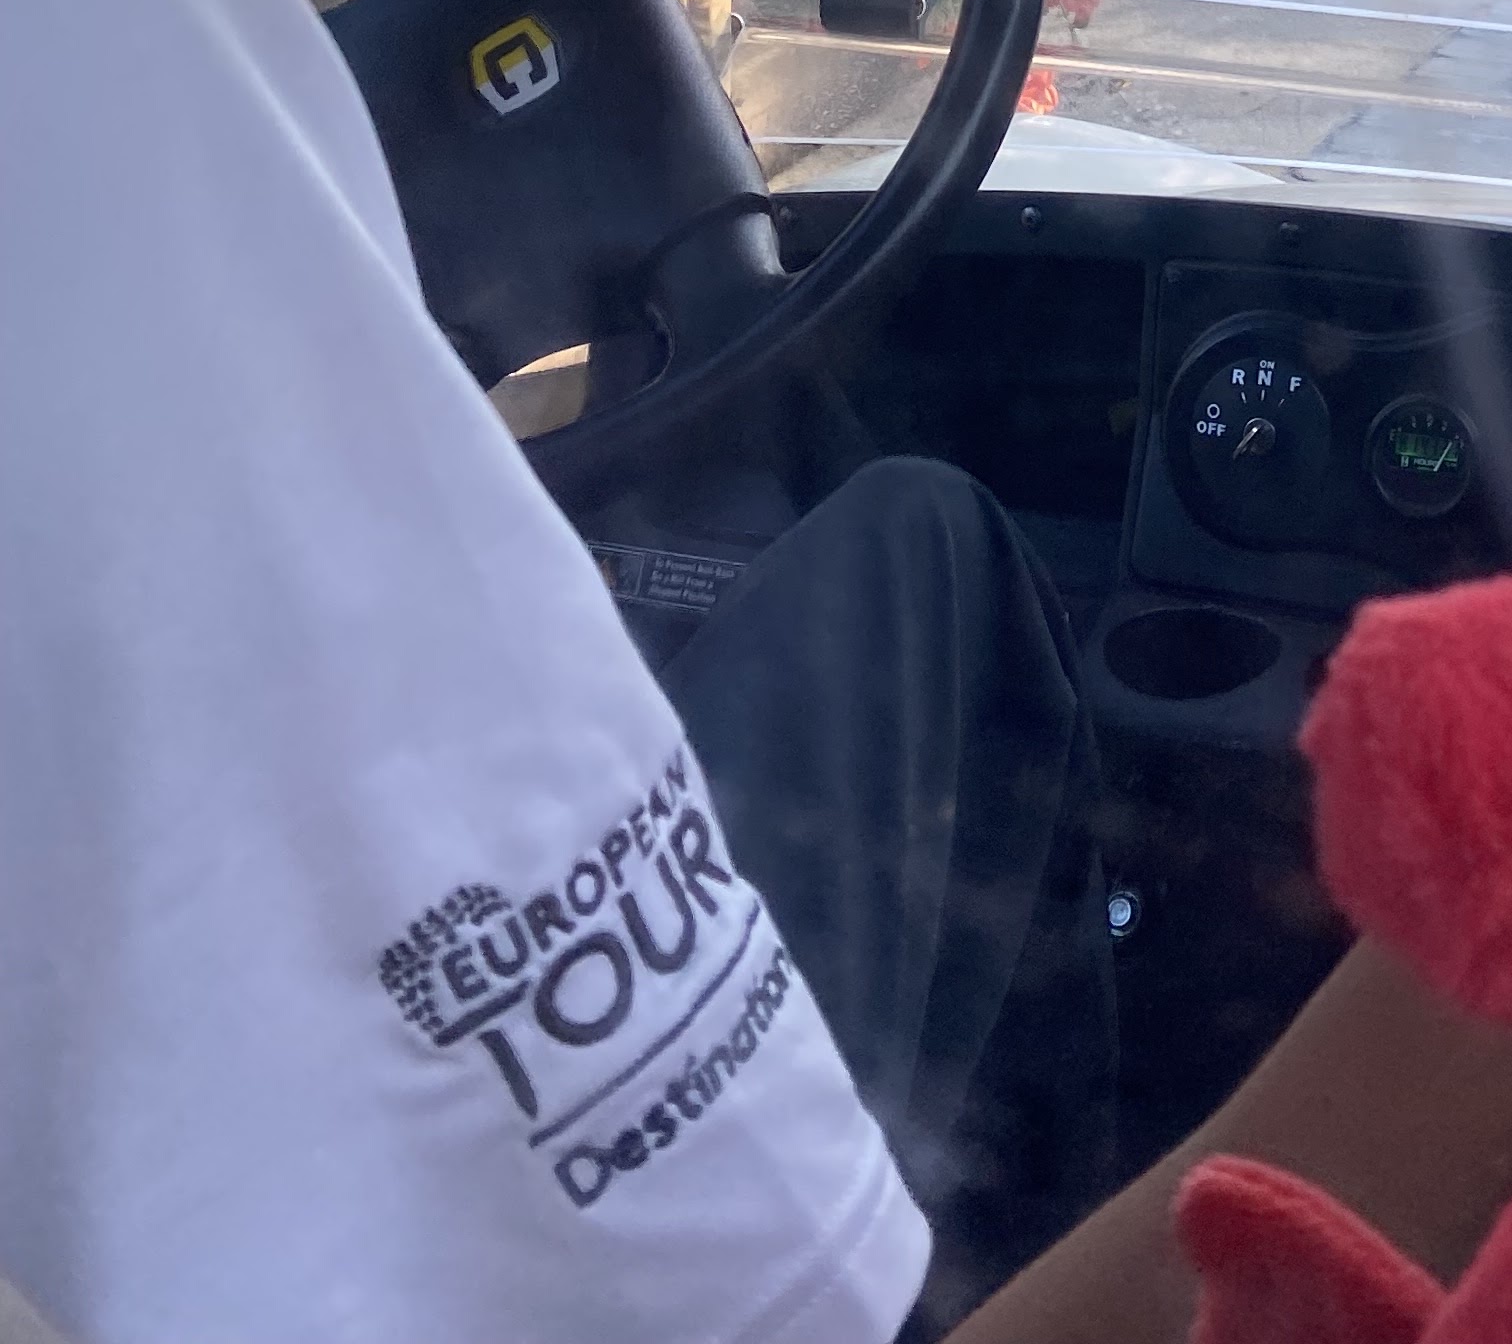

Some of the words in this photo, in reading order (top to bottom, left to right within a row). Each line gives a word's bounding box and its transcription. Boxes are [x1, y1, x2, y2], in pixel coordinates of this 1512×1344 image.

[1259, 359, 1275, 370] ON
[1231, 368, 1246, 385] R
[1257, 369, 1273, 386] N
[1289, 376, 1303, 392] F
[1196, 420, 1227, 437] OFF
[441, 746, 687, 1002] EUROPEAN
[434, 806, 732, 1120] TOUR
